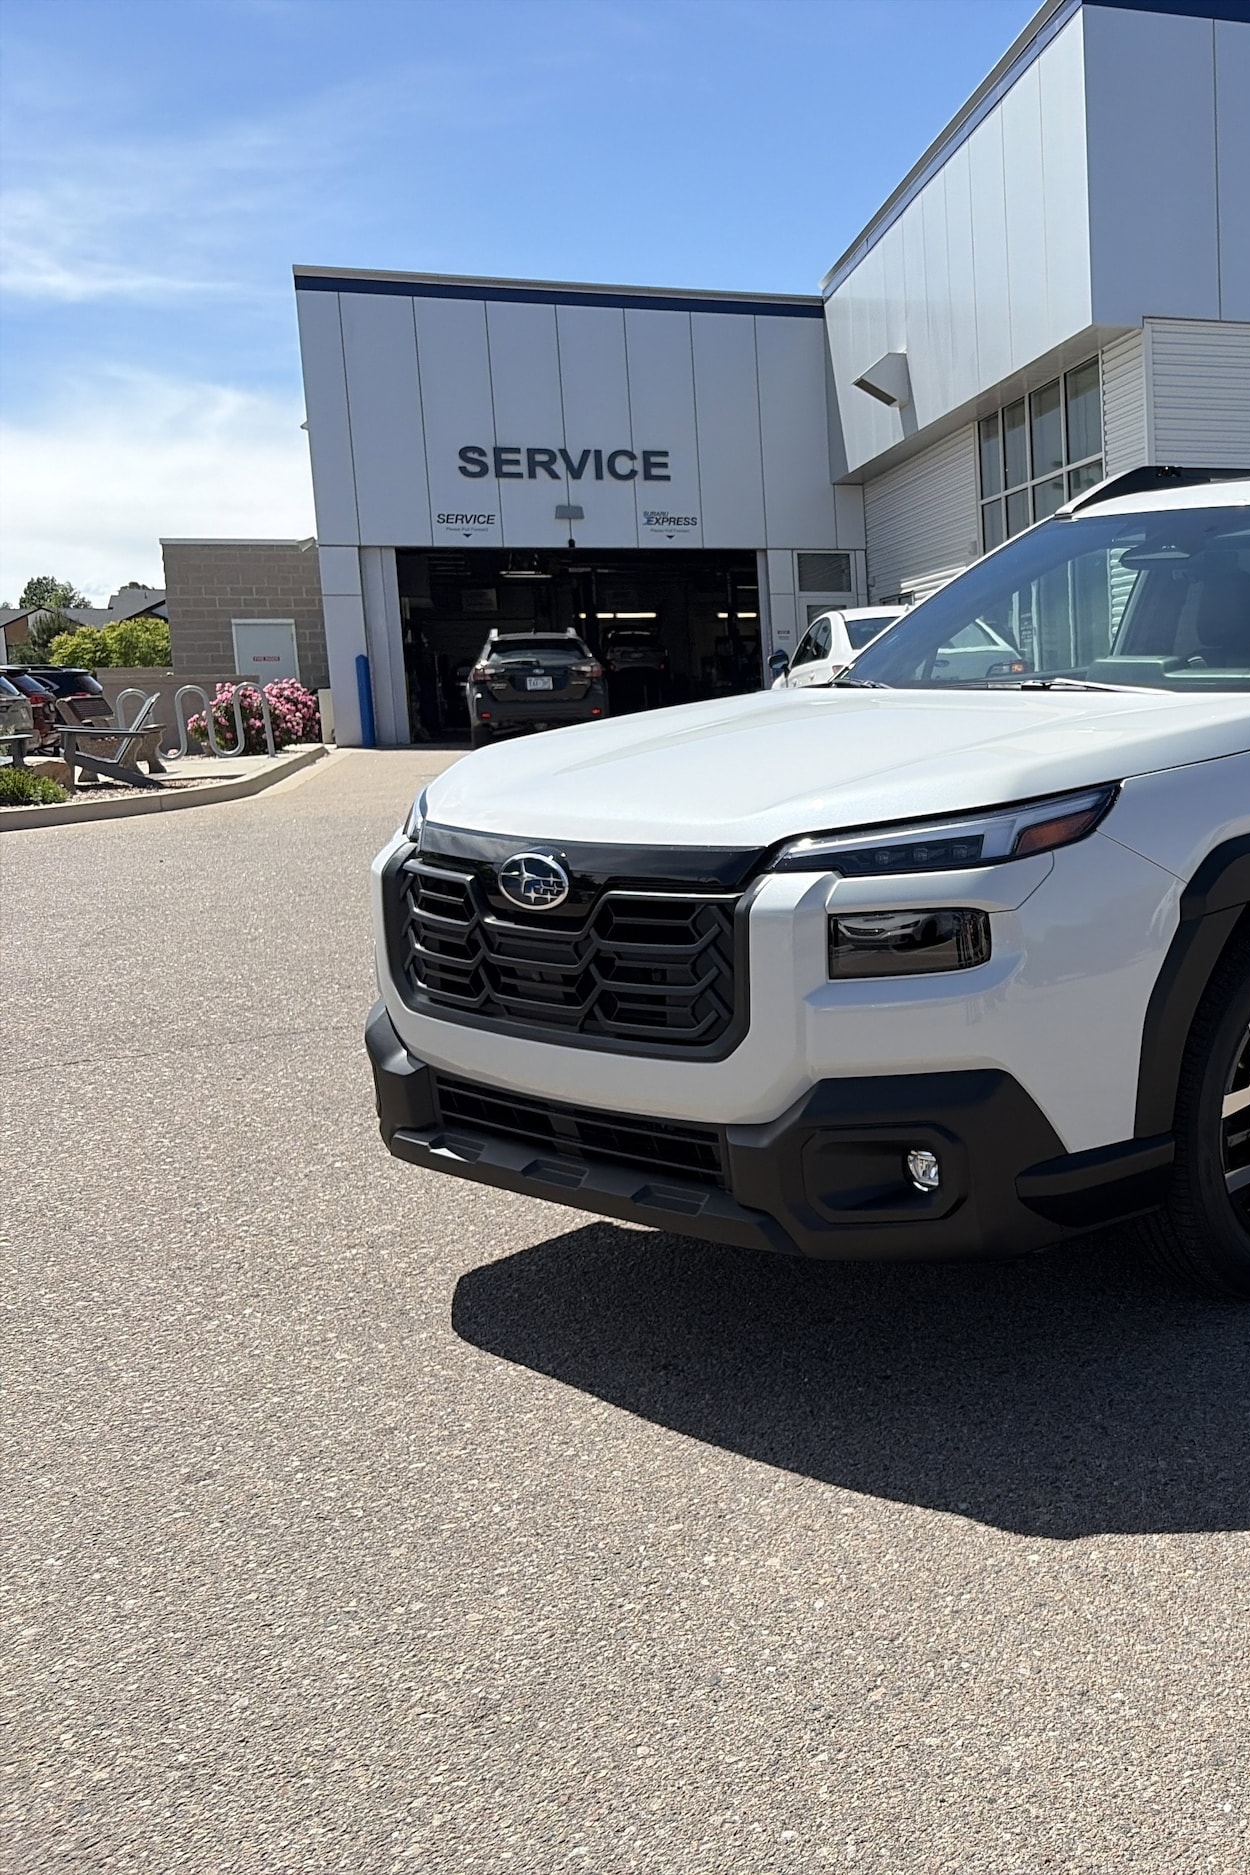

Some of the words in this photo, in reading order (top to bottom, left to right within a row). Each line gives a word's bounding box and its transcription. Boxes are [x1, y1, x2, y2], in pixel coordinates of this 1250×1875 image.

[457, 445, 672, 482] SERVICE
[436, 513, 496, 525] SERVICE
[642, 515, 698, 526] EXPRESS
